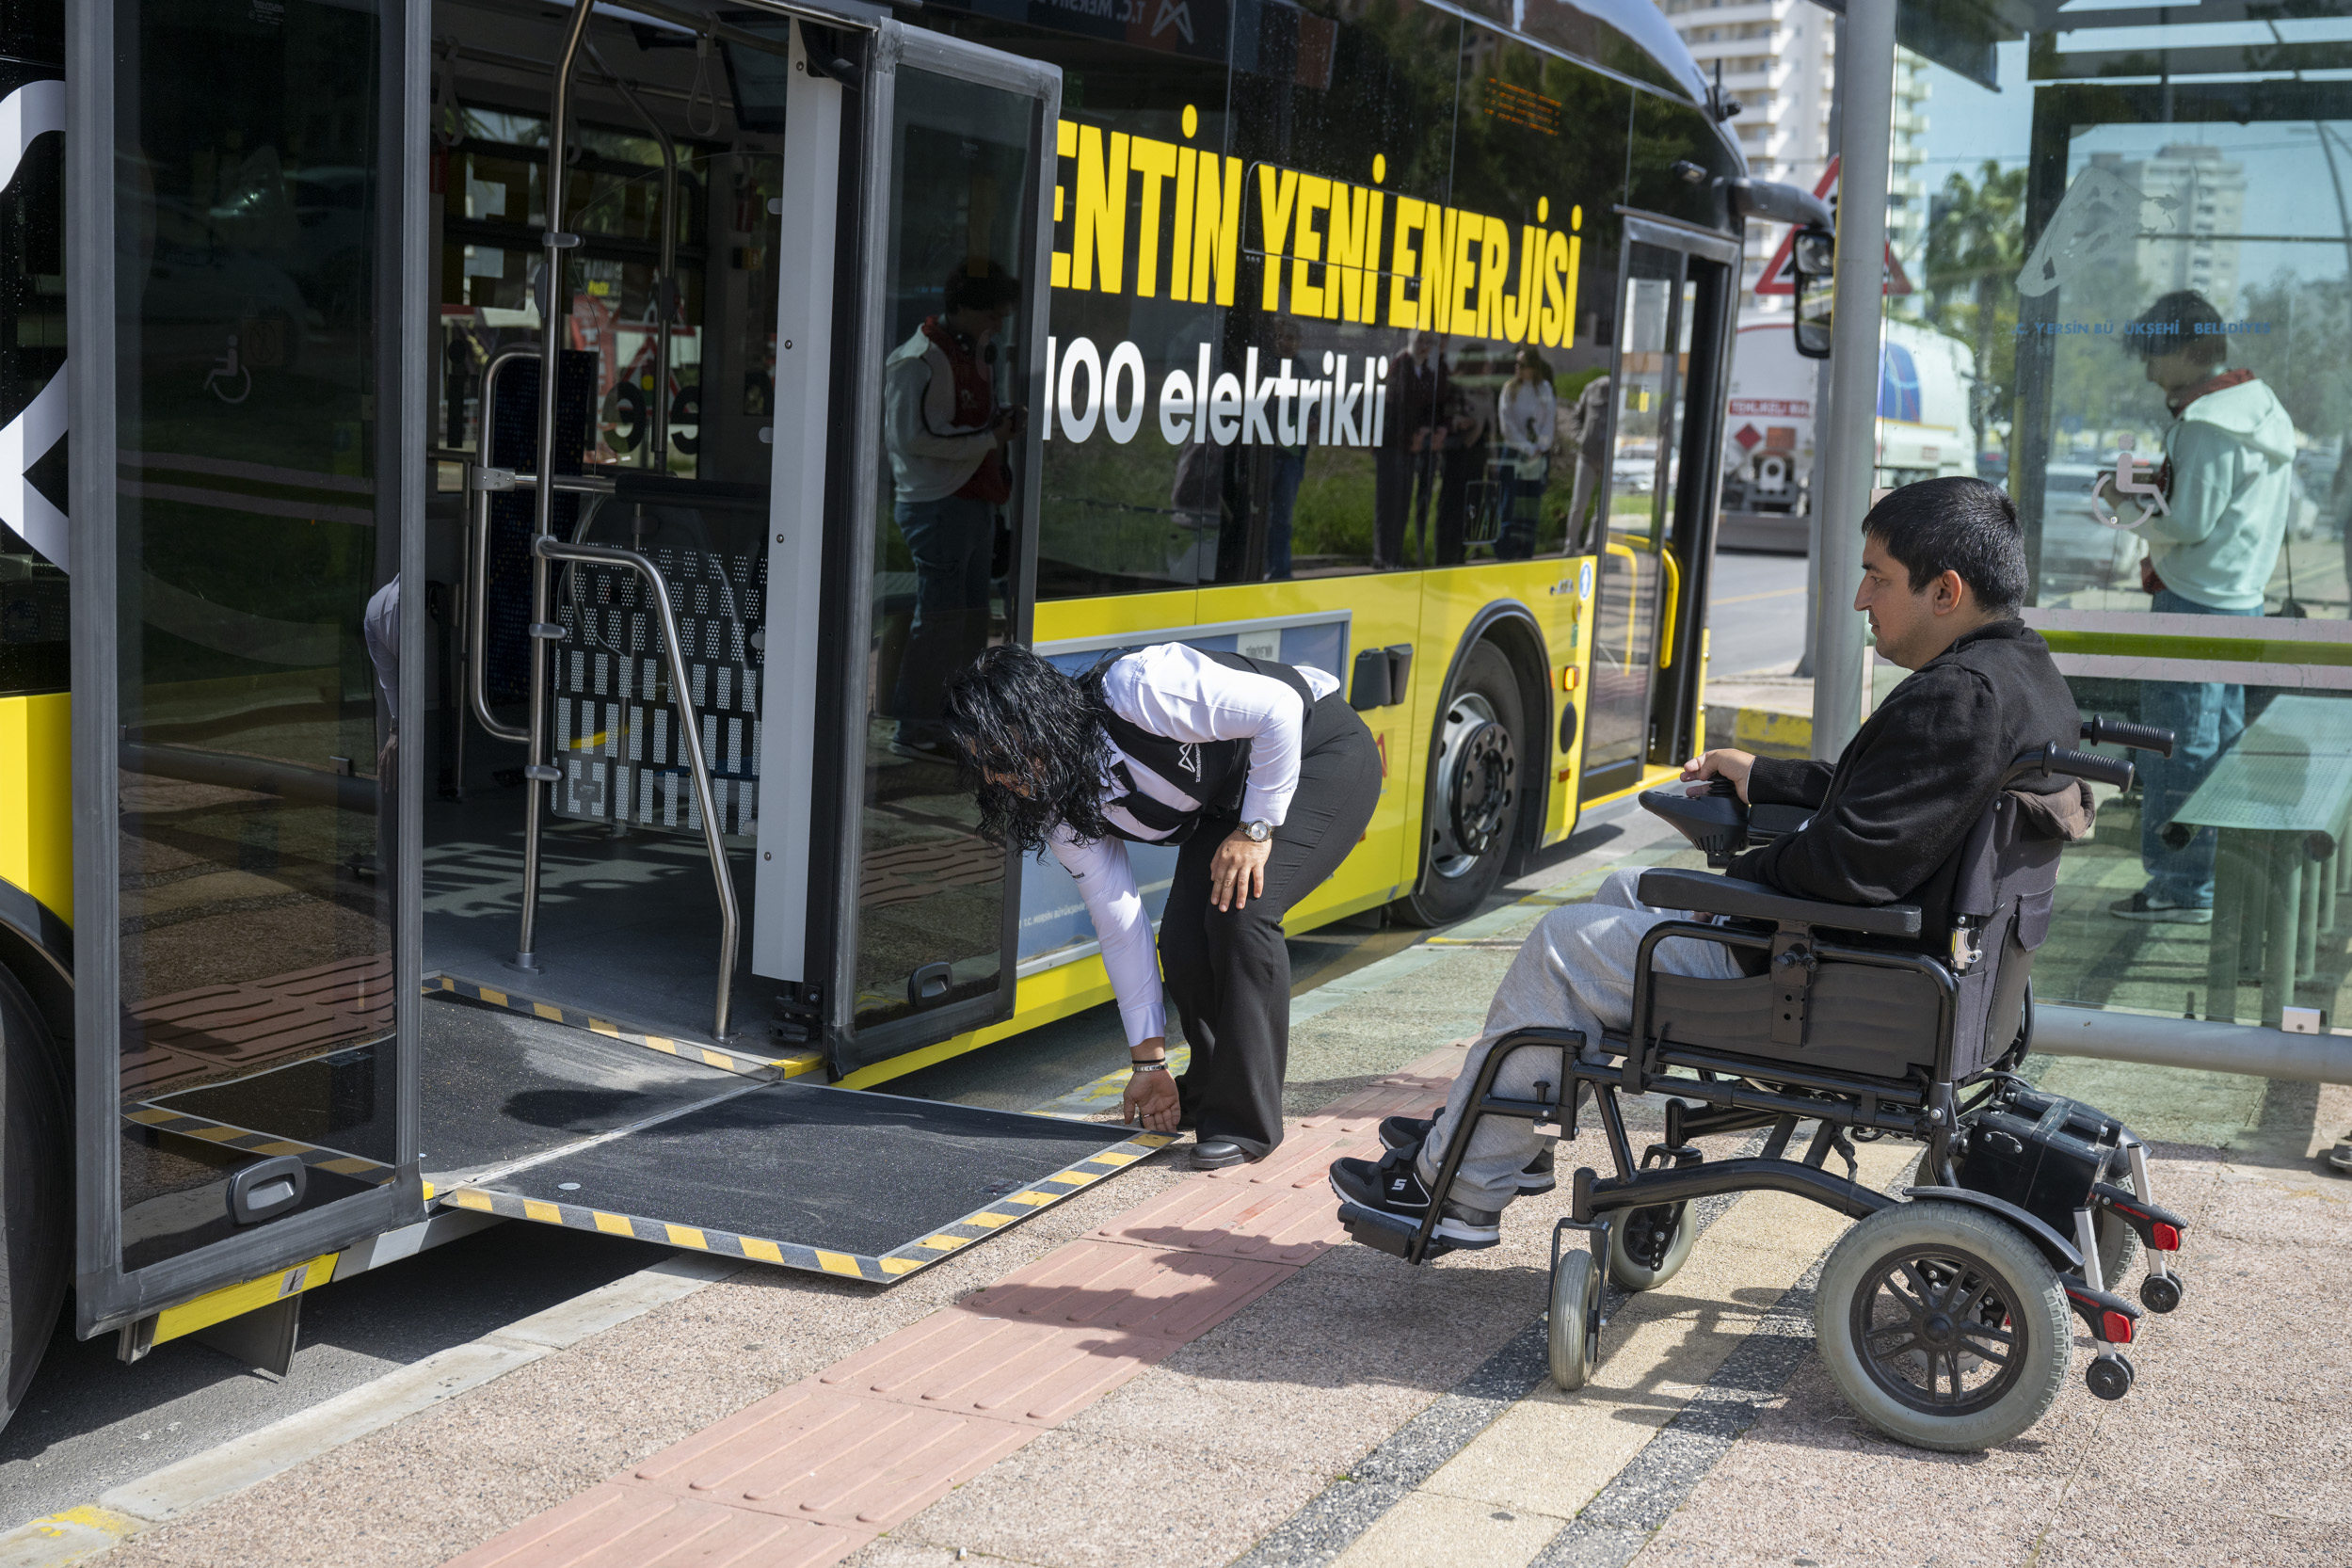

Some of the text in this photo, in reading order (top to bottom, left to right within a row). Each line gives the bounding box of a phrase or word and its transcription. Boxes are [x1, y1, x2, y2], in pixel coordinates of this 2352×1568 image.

[1258, 153, 1385, 325] YENİ
[1388, 196, 1582, 349] ENERJİSİ
[1160, 343, 1388, 448] elektrikli
